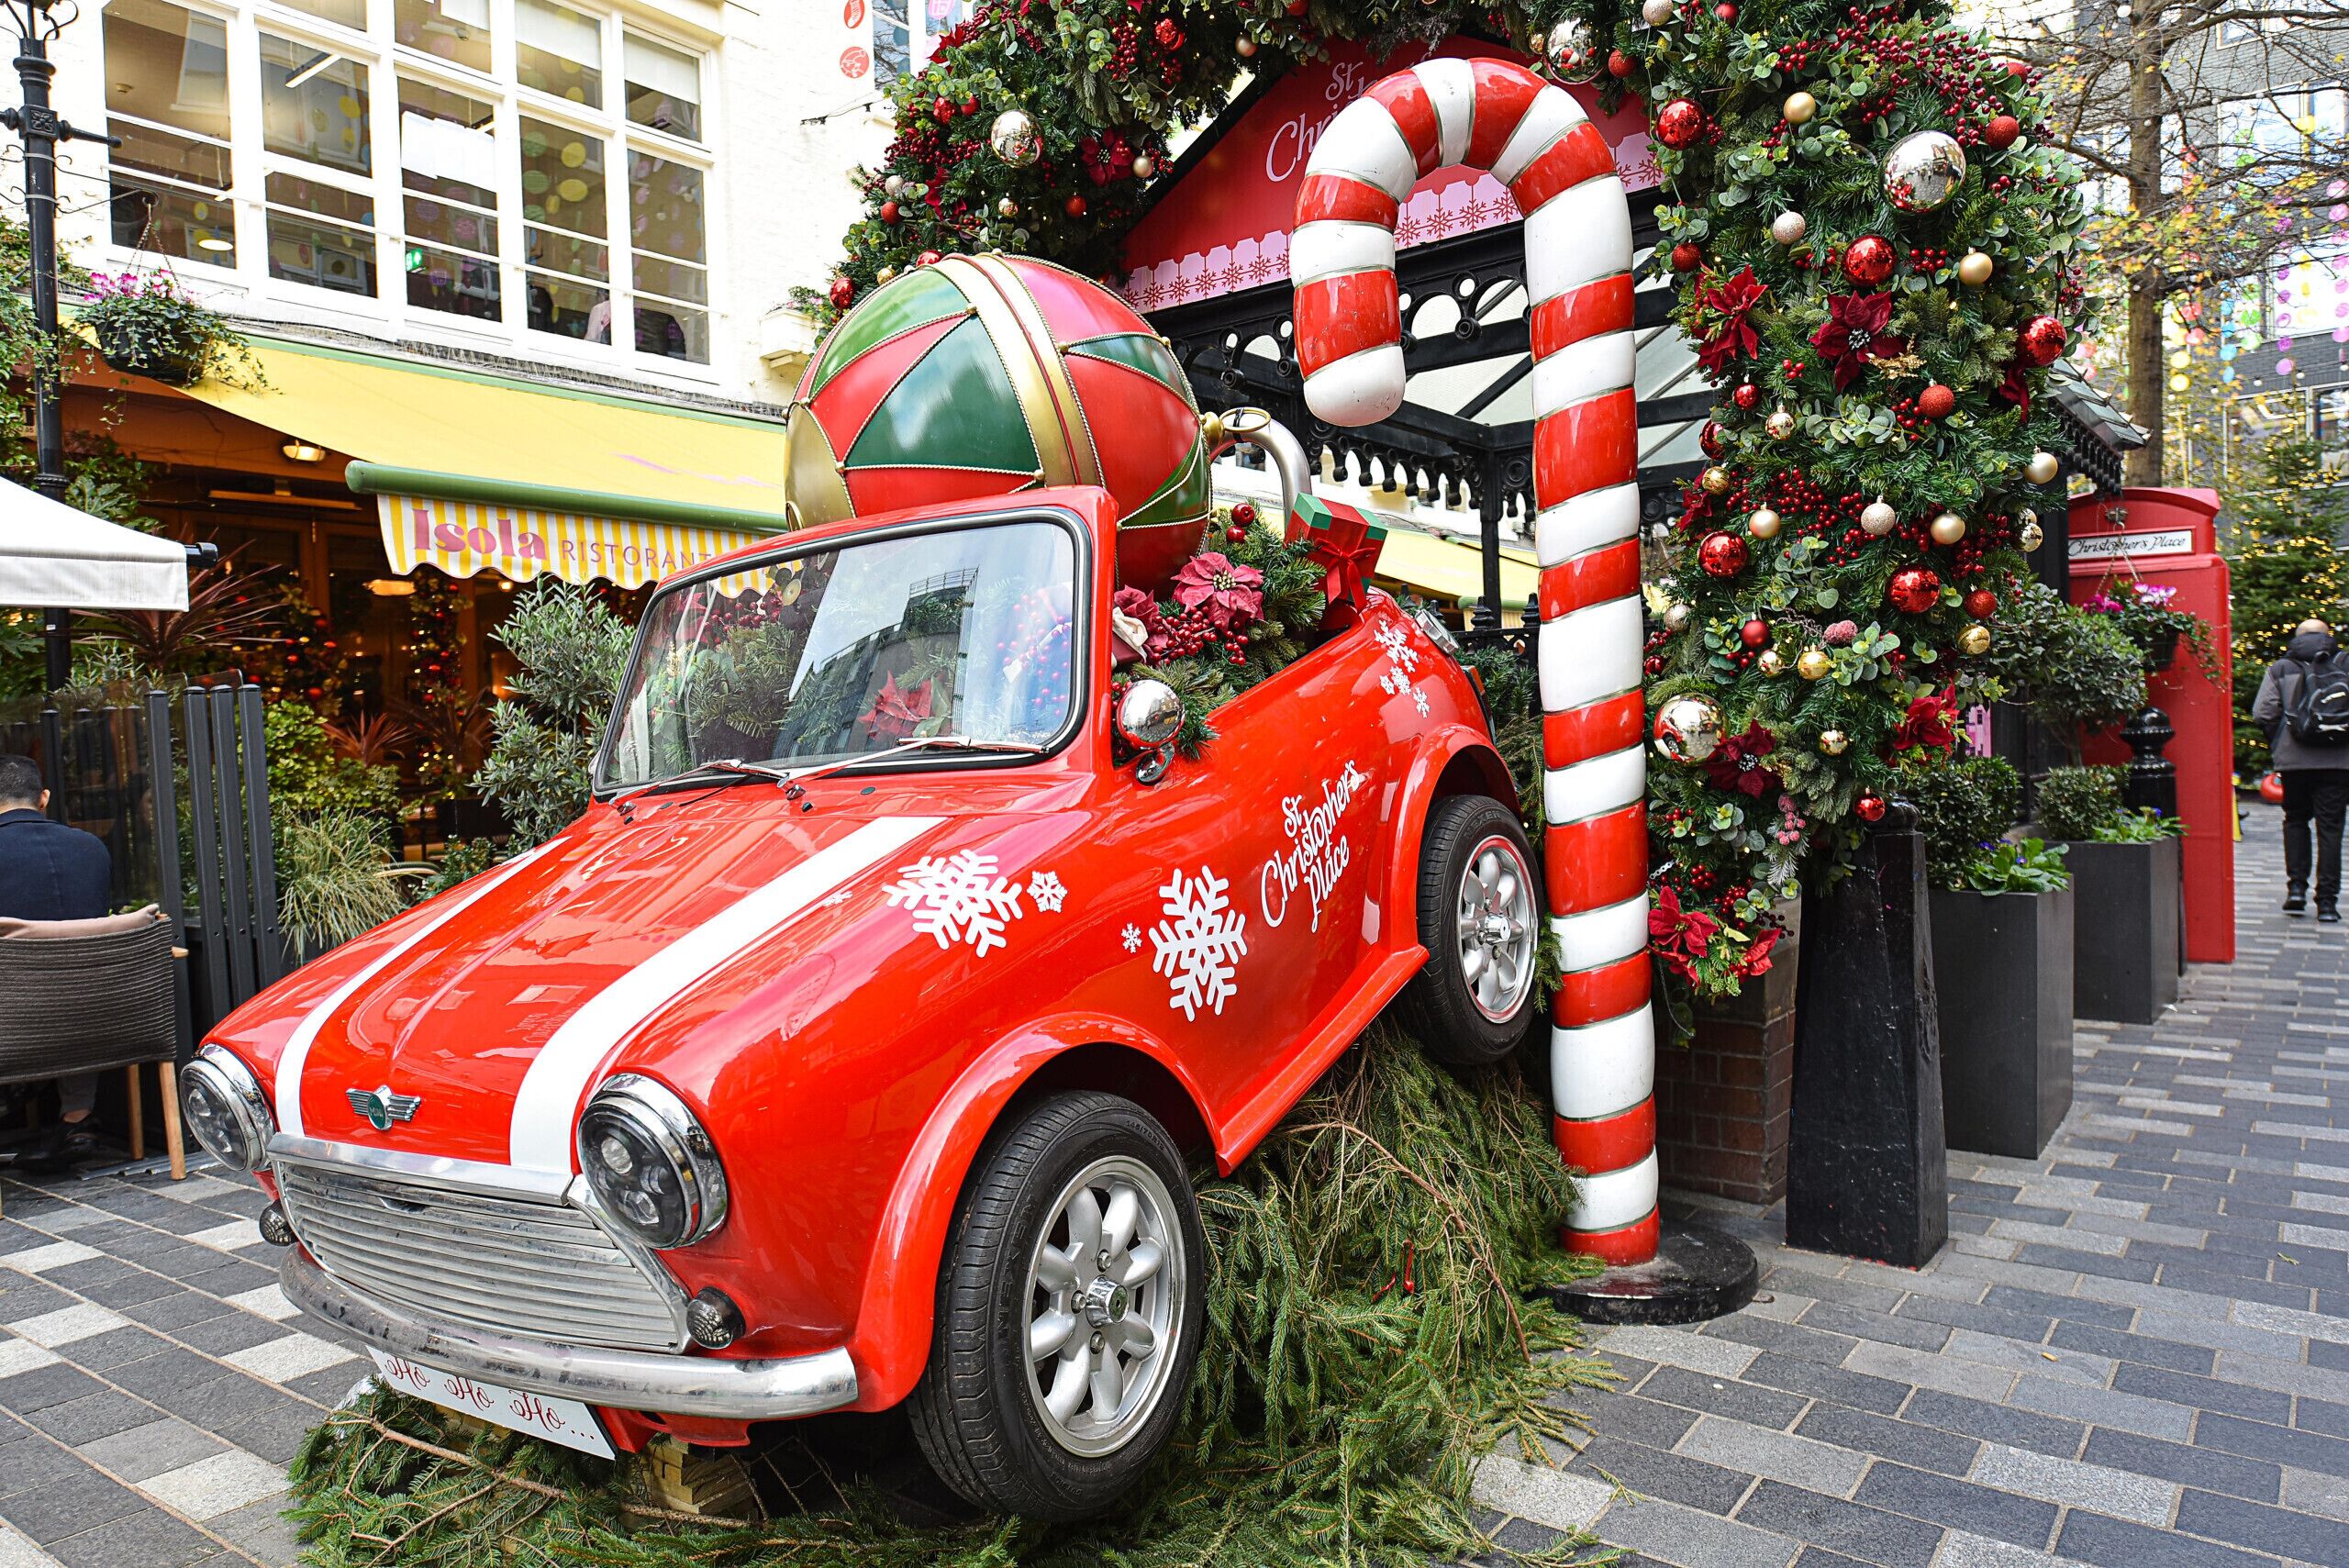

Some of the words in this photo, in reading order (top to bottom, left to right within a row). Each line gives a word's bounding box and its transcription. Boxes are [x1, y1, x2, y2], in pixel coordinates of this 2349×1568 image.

[1325, 61, 1364, 101] St
[413, 508, 547, 561] Isola
[562, 539, 712, 569] RISTORANT
[2147, 535, 2186, 551] Place
[1282, 794, 1303, 838] St
[384, 1356, 430, 1391] Ho
[444, 1375, 495, 1411] Ho
